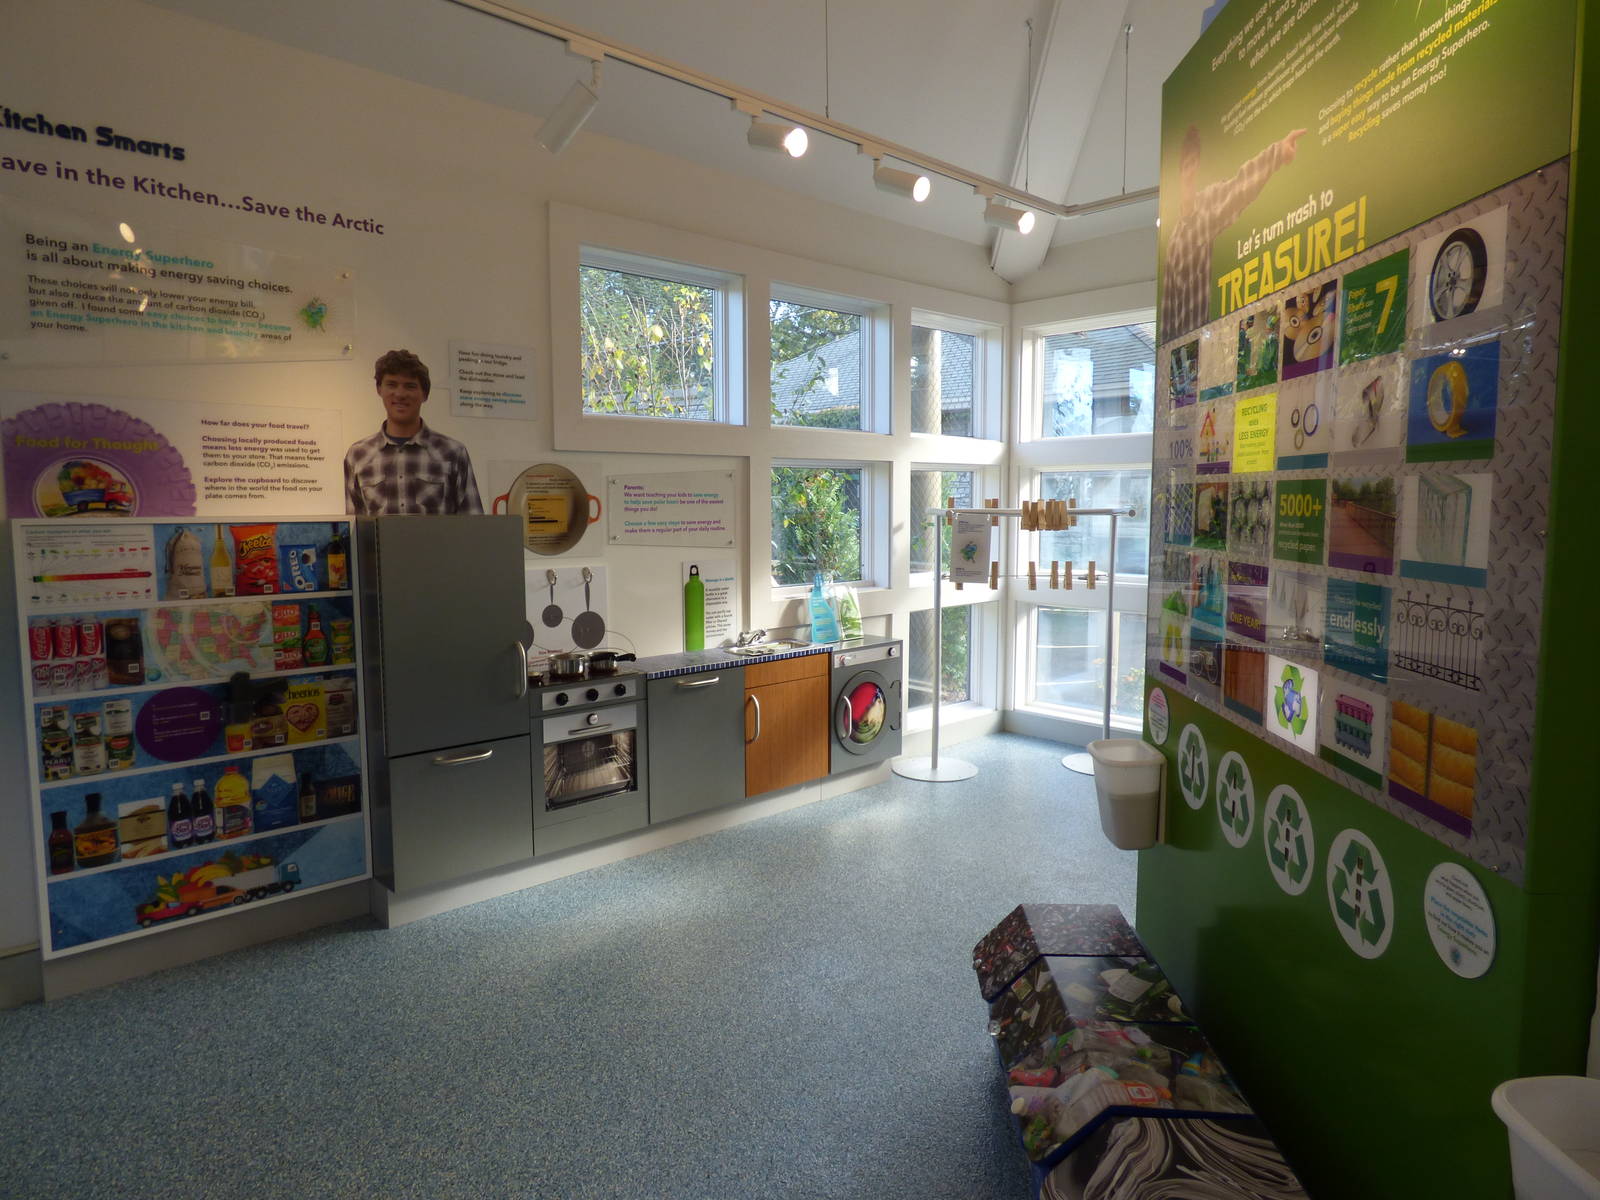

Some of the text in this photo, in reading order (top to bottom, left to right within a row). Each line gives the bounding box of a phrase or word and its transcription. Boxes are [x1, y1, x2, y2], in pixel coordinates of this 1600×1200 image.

[1211, 3, 1268, 72] Everything we use
[1238, 48, 1246, 61] to
[1246, 25, 1266, 52] move
[1250, 43, 1269, 69] when
[1270, 30, 1282, 47] we
[1282, 15, 1296, 35] are
[1318, 0, 1471, 121] Choosing to recycle rather than throw things
[1350, 109, 1366, 126] easy
[1366, 98, 1381, 114] way
[1381, 93, 1390, 103] to
[1390, 83, 1401, 97] be
[1400, 76, 1412, 89] an
[1412, 54, 1441, 81] Energy
[1441, 19, 1491, 60] Superhero.
[1318, 120, 1330, 135] and
[1330, 104, 1351, 127] buying
[1352, 88, 1374, 110] things
[1374, 71, 1395, 92] made
[1396, 56, 1415, 75] from
[1416, 24, 1453, 62] recycled
[1348, 65, 1448, 143] Recycling saves money too!
[96, 126, 186, 161] Smarts
[1, 157, 47, 176] ave
[56, 161, 78, 181] in
[86, 168, 125, 189] the
[295, 206, 327, 224] the
[332, 213, 384, 235] Arctic
[1237, 189, 1334, 260] Let's turn trash to
[26, 234, 214, 269] Being an Energy Superhero
[1217, 194, 1367, 316] TREASURE!
[26, 249, 293, 293] is all about making energy saving choices.
[28, 275, 238, 307] These choices will not only lower your energy
[28, 286, 45, 296] but
[49, 288, 69, 298] also
[72, 290, 105, 301] reduce
[109, 295, 124, 304] the
[127, 299, 161, 308] amunt
[164, 301, 173, 309] of
[176, 303, 206, 312] carbon
[208, 306, 240, 316] dioxide
[30, 299, 57, 307] given
[88, 303, 116, 313] found
[1376, 274, 1398, 336] 7
[31, 321, 87, 332] your home.
[232, 420, 249, 428] does
[1241, 403, 1267, 416] RECYCLING
[15, 435, 158, 454] Food for Thought
[202, 435, 237, 444] Choosing
[238, 437, 262, 445] locally
[1170, 438, 1193, 459] 100%
[1239, 428, 1268, 440] LESS ENERGY
[1280, 494, 1322, 517] 5000+
[289, 549, 305, 588] OREO
[1231, 612, 1243, 624] ONE
[1330, 611, 1385, 643] endlessly
[288, 687, 321, 700] heerios
